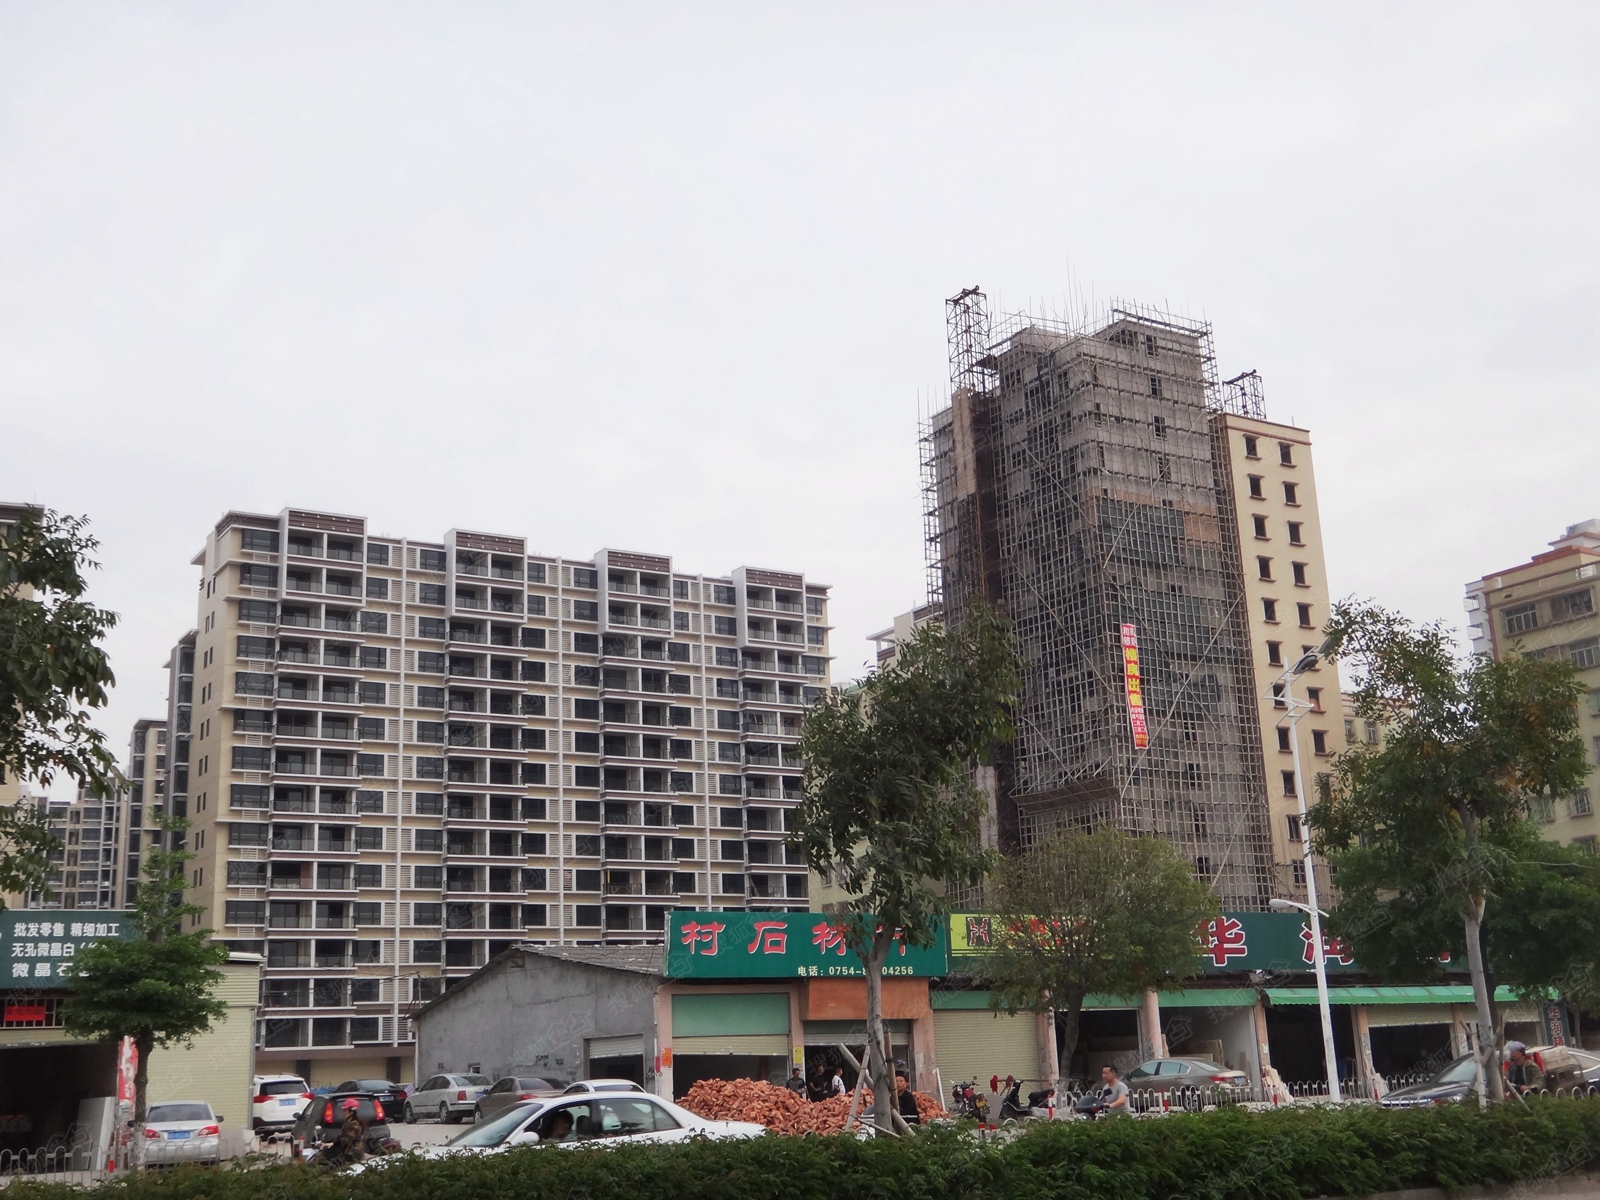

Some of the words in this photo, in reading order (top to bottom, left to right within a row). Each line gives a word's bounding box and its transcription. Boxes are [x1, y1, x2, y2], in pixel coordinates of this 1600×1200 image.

[13, 922, 65, 937] 批发零售
[70, 922, 120, 937] 精细加工
[679, 919, 908, 957] 村石材
[11, 942, 75, 957] 无孔微晶白
